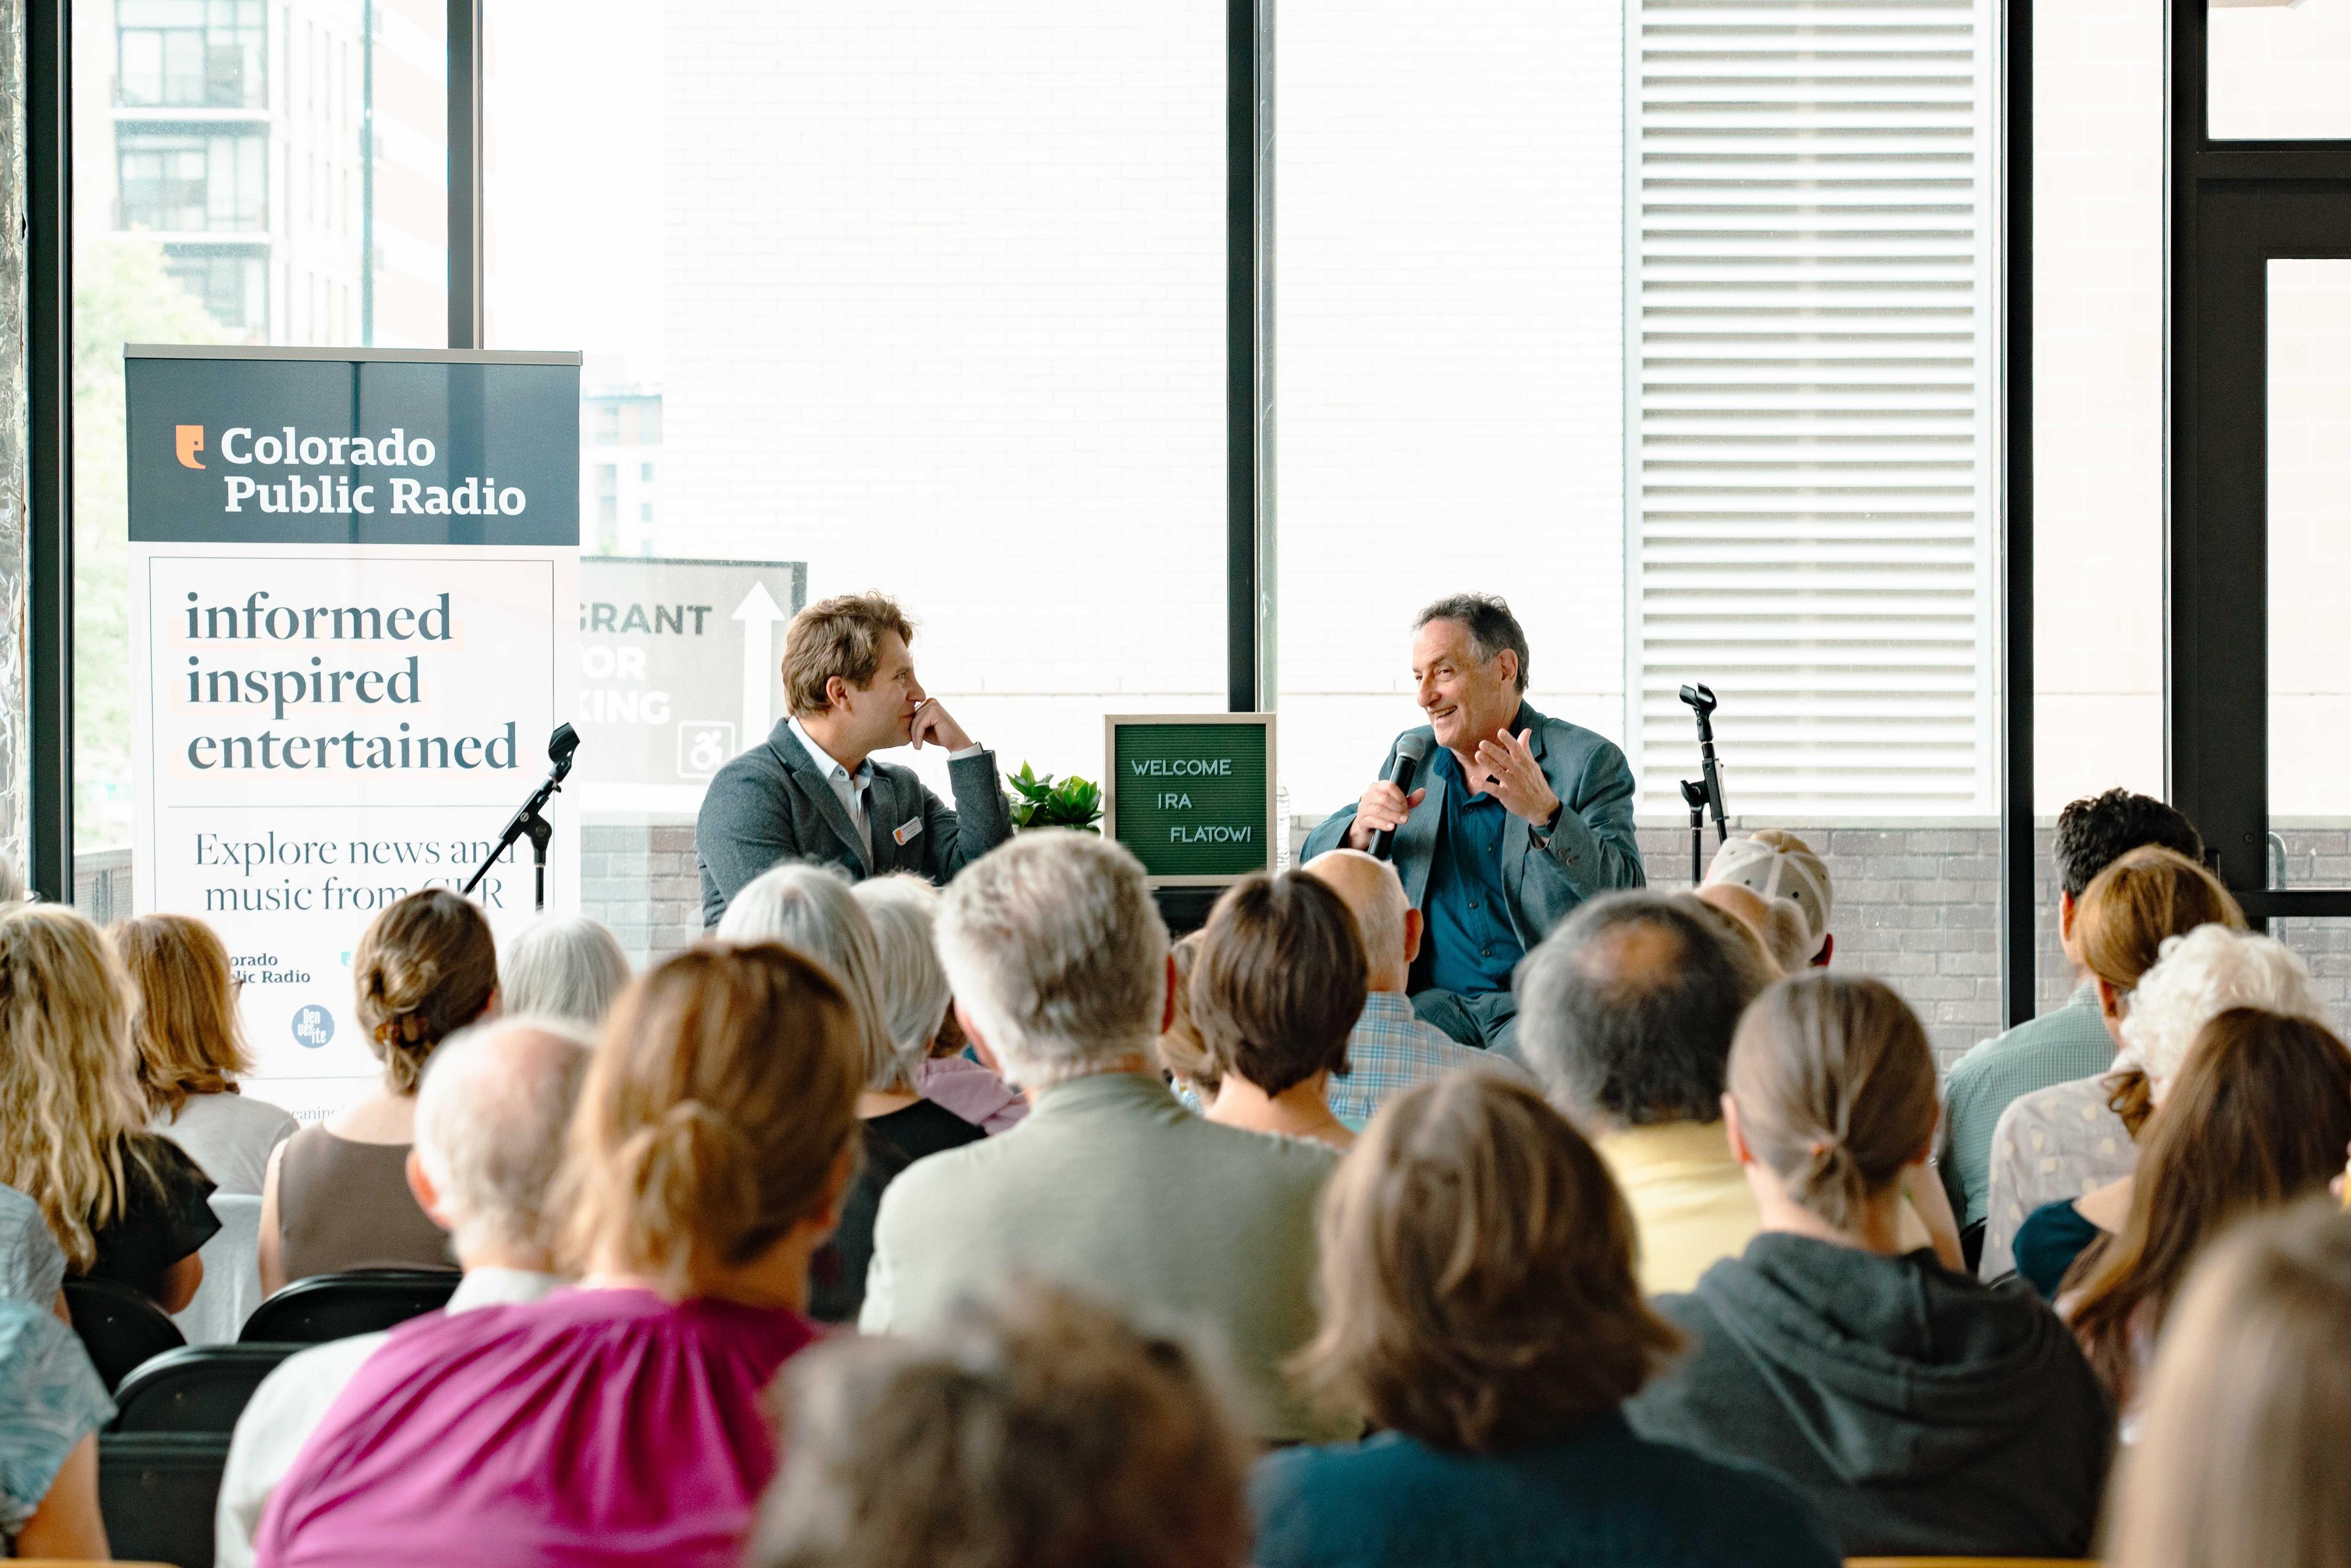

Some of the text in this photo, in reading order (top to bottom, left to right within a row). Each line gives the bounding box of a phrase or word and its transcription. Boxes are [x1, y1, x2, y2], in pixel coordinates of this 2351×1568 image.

[221, 426, 435, 466] Colorado
[224, 475, 526, 516] Public Radio
[185, 591, 453, 640] informed
[580, 645, 646, 680] OR
[186, 655, 422, 720] inspired
[188, 722, 519, 769] entertained
[1131, 759, 1232, 776] WELCOME
[1158, 793, 1192, 809] IRA
[1171, 825, 1251, 843] FLATOW!
[194, 831, 337, 877] Explore
[349, 841, 440, 865] news
[205, 877, 312, 911] music
[322, 877, 408, 911] from
[230, 953, 278, 966] orado
[236, 970, 310, 983] lic Radio
